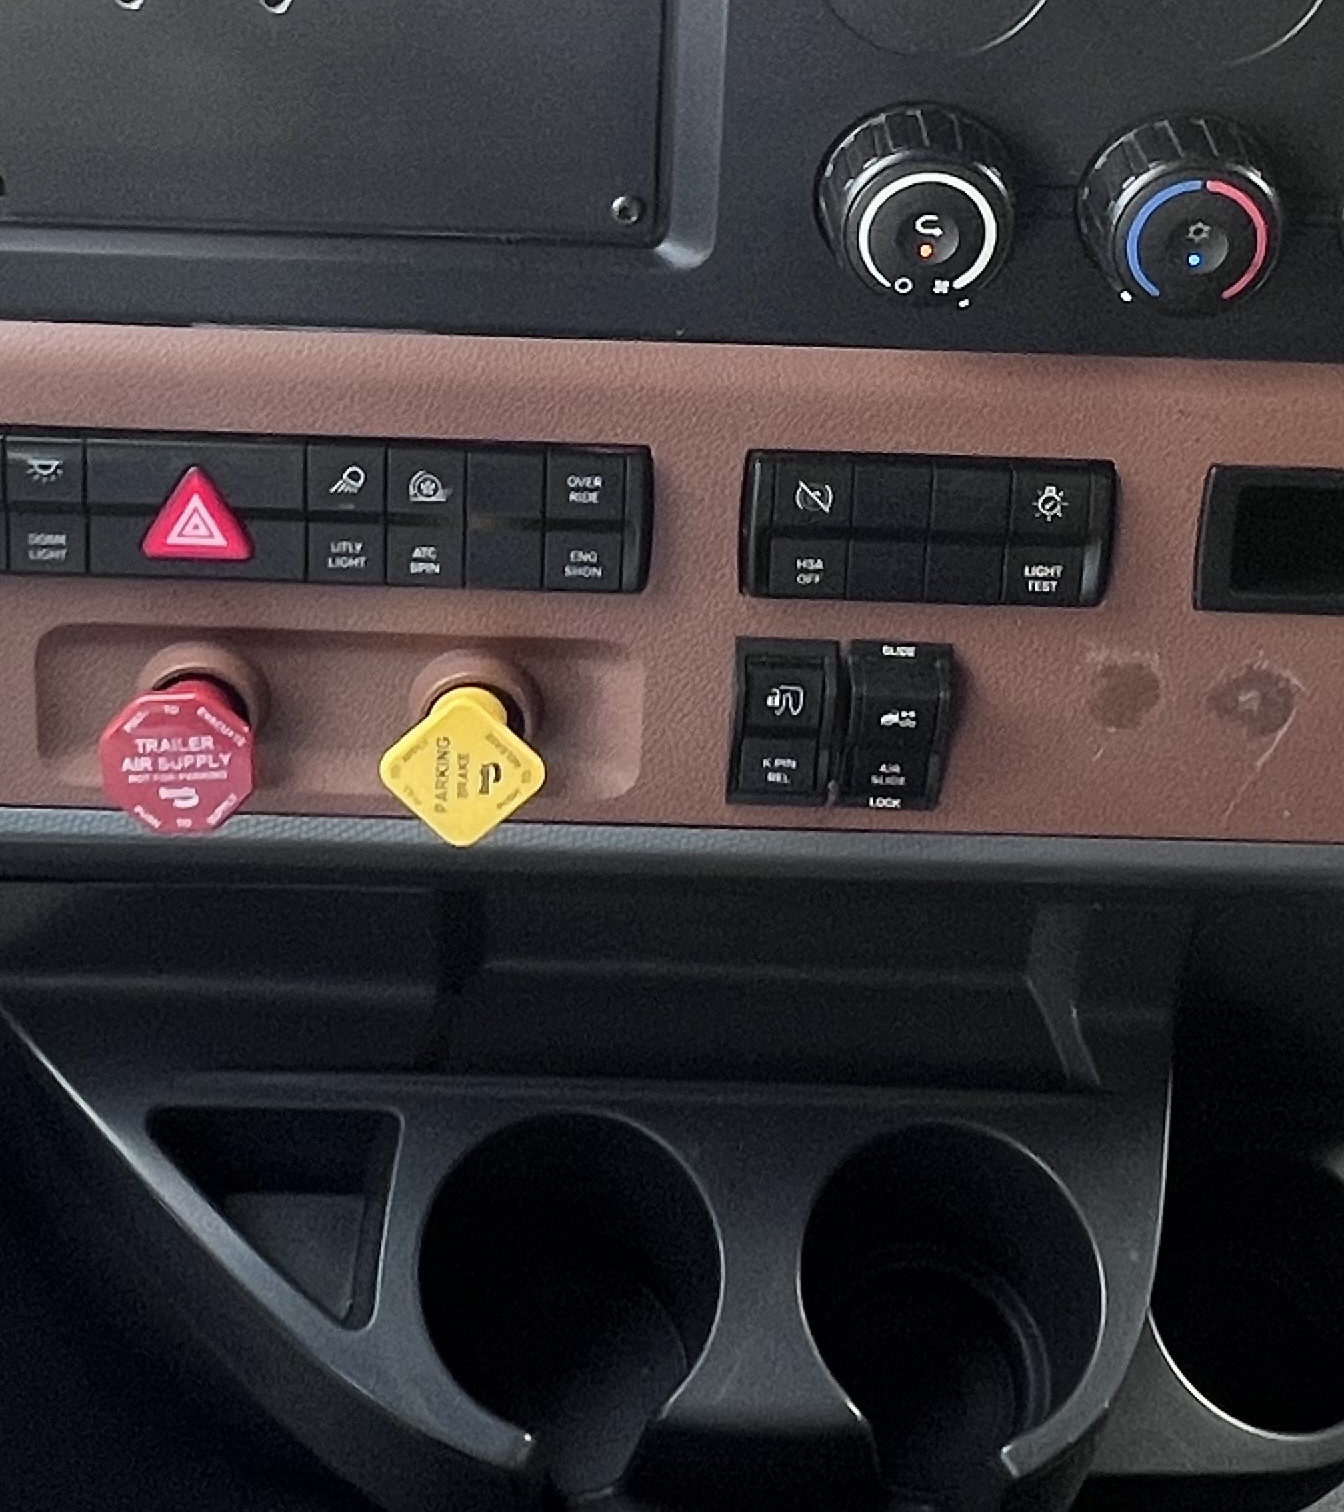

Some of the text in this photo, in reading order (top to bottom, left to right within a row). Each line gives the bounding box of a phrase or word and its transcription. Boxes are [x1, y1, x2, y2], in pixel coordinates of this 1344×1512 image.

[567, 475, 602, 488] OVER
[569, 491, 599, 503] RIDE
[327, 557, 366, 568] LIGHT
[570, 550, 598, 563] ENG
[1024, 564, 1064, 578] LIGHT
[1028, 580, 1058, 592] TEST
[134, 735, 215, 754] TRAILER
[121, 752, 232, 772] AIR SUPPLY
[435, 736, 452, 814] PARKING
[869, 796, 902, 808] LOCK
